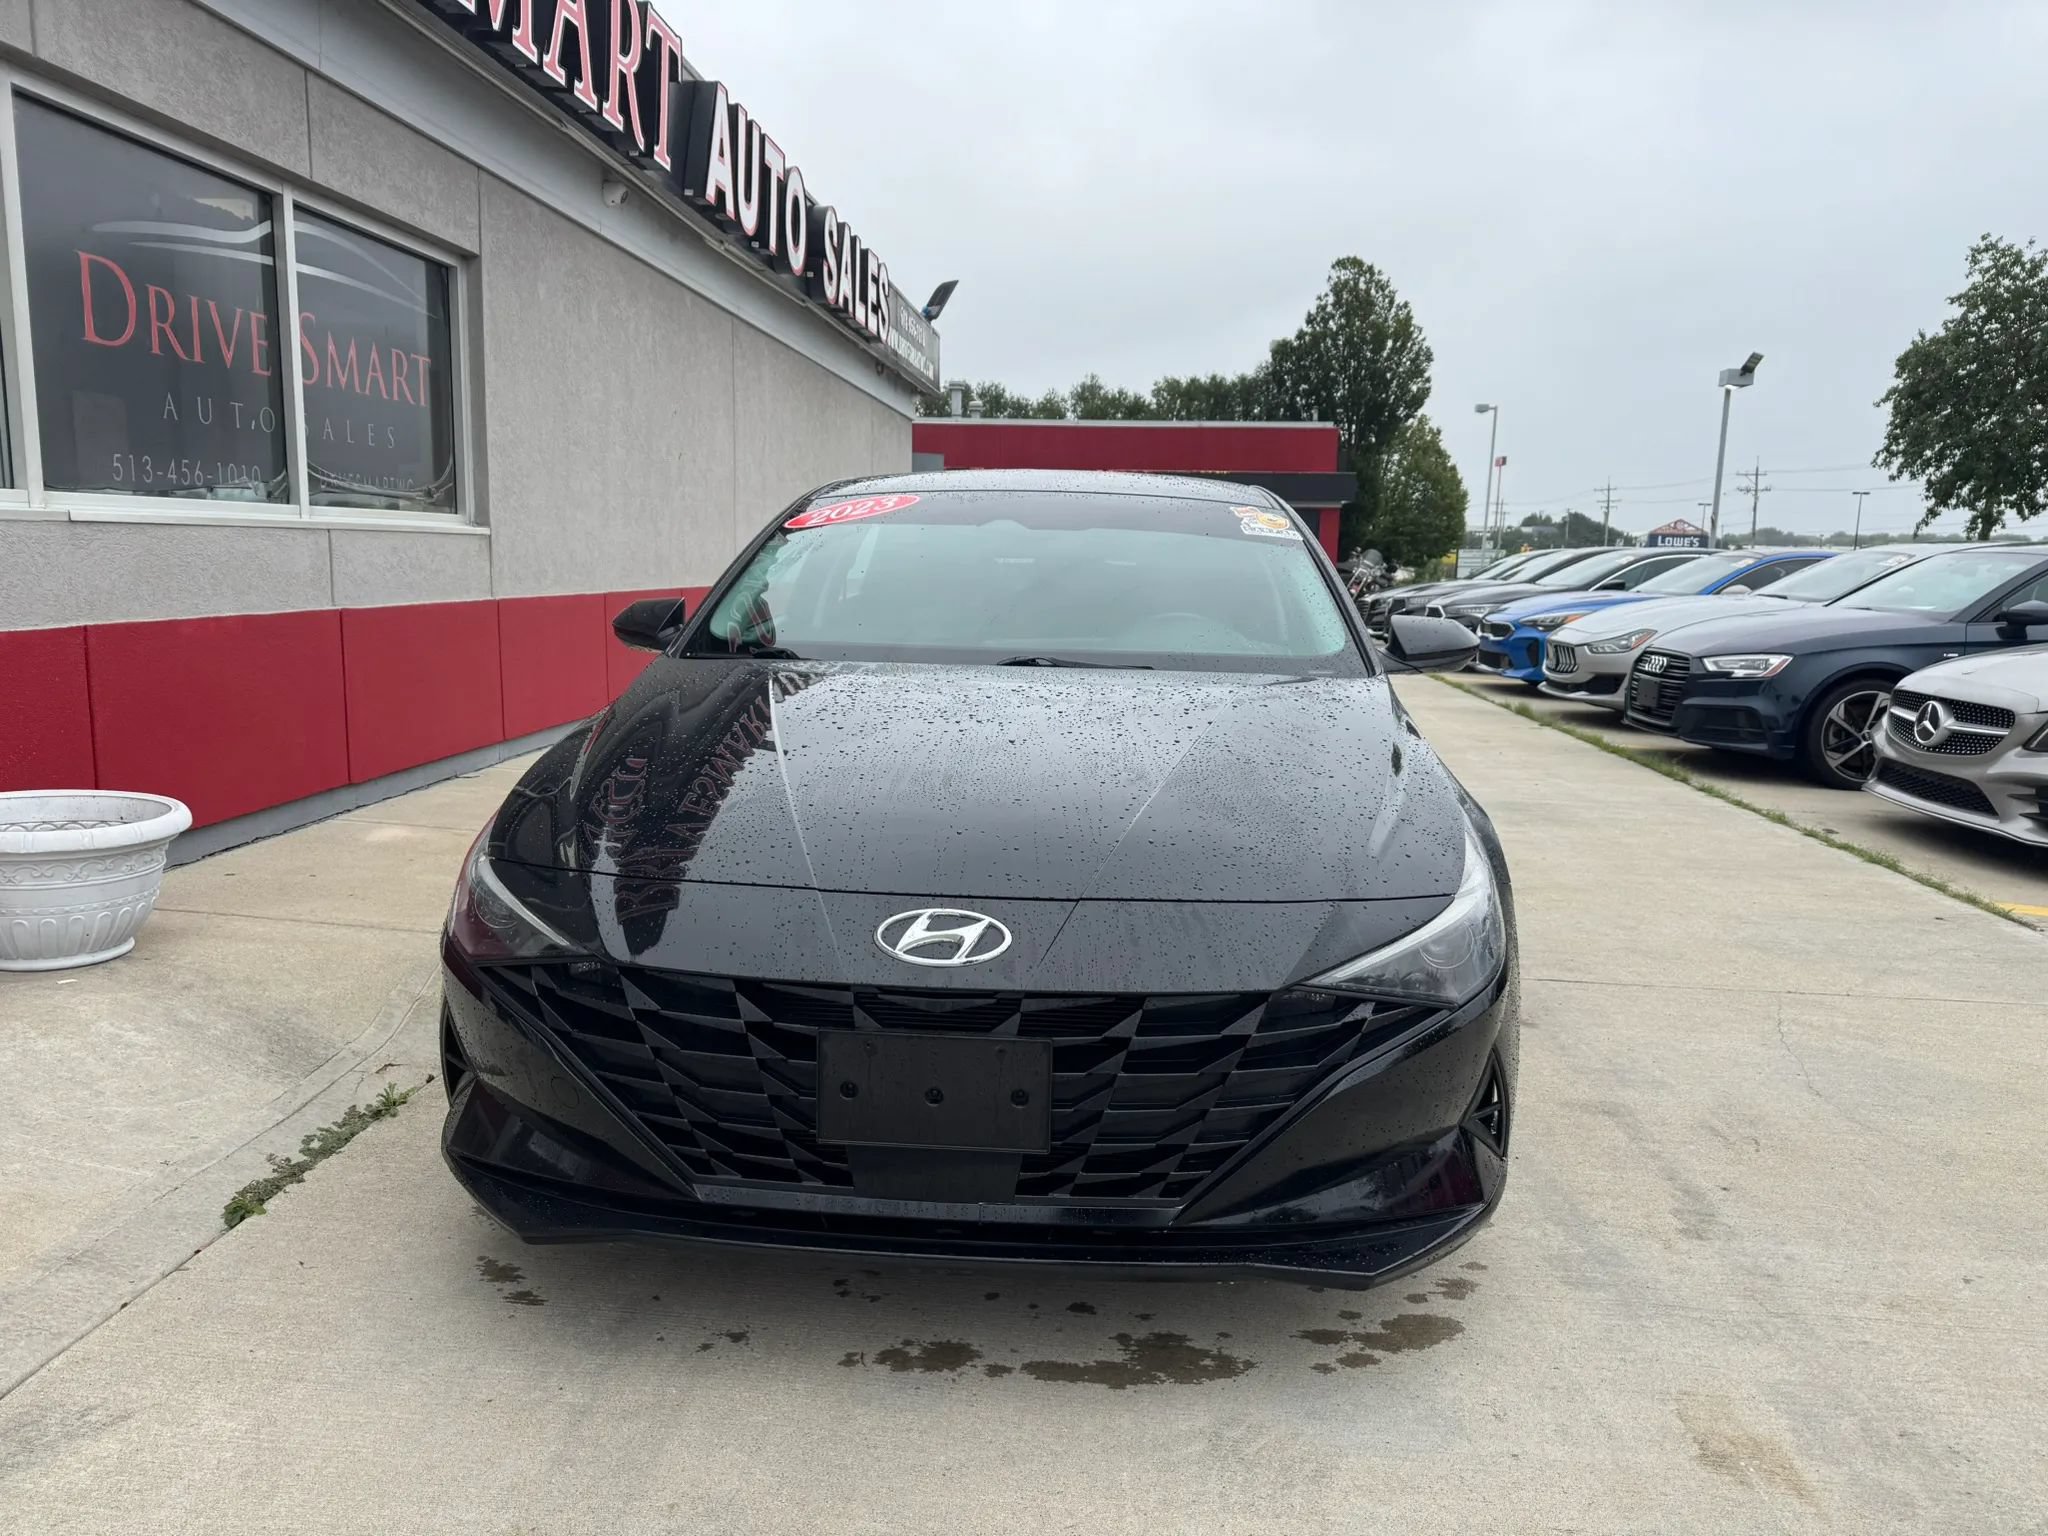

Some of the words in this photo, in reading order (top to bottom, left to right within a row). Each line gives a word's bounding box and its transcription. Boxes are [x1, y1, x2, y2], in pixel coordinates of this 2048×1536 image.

[706, 81, 807, 277] AUTO
[823, 205, 890, 345] SALES
[163, 391, 277, 434] AUTO
[806, 497, 899, 525] 2023
[1657, 535, 1701, 547] LOWE'S
